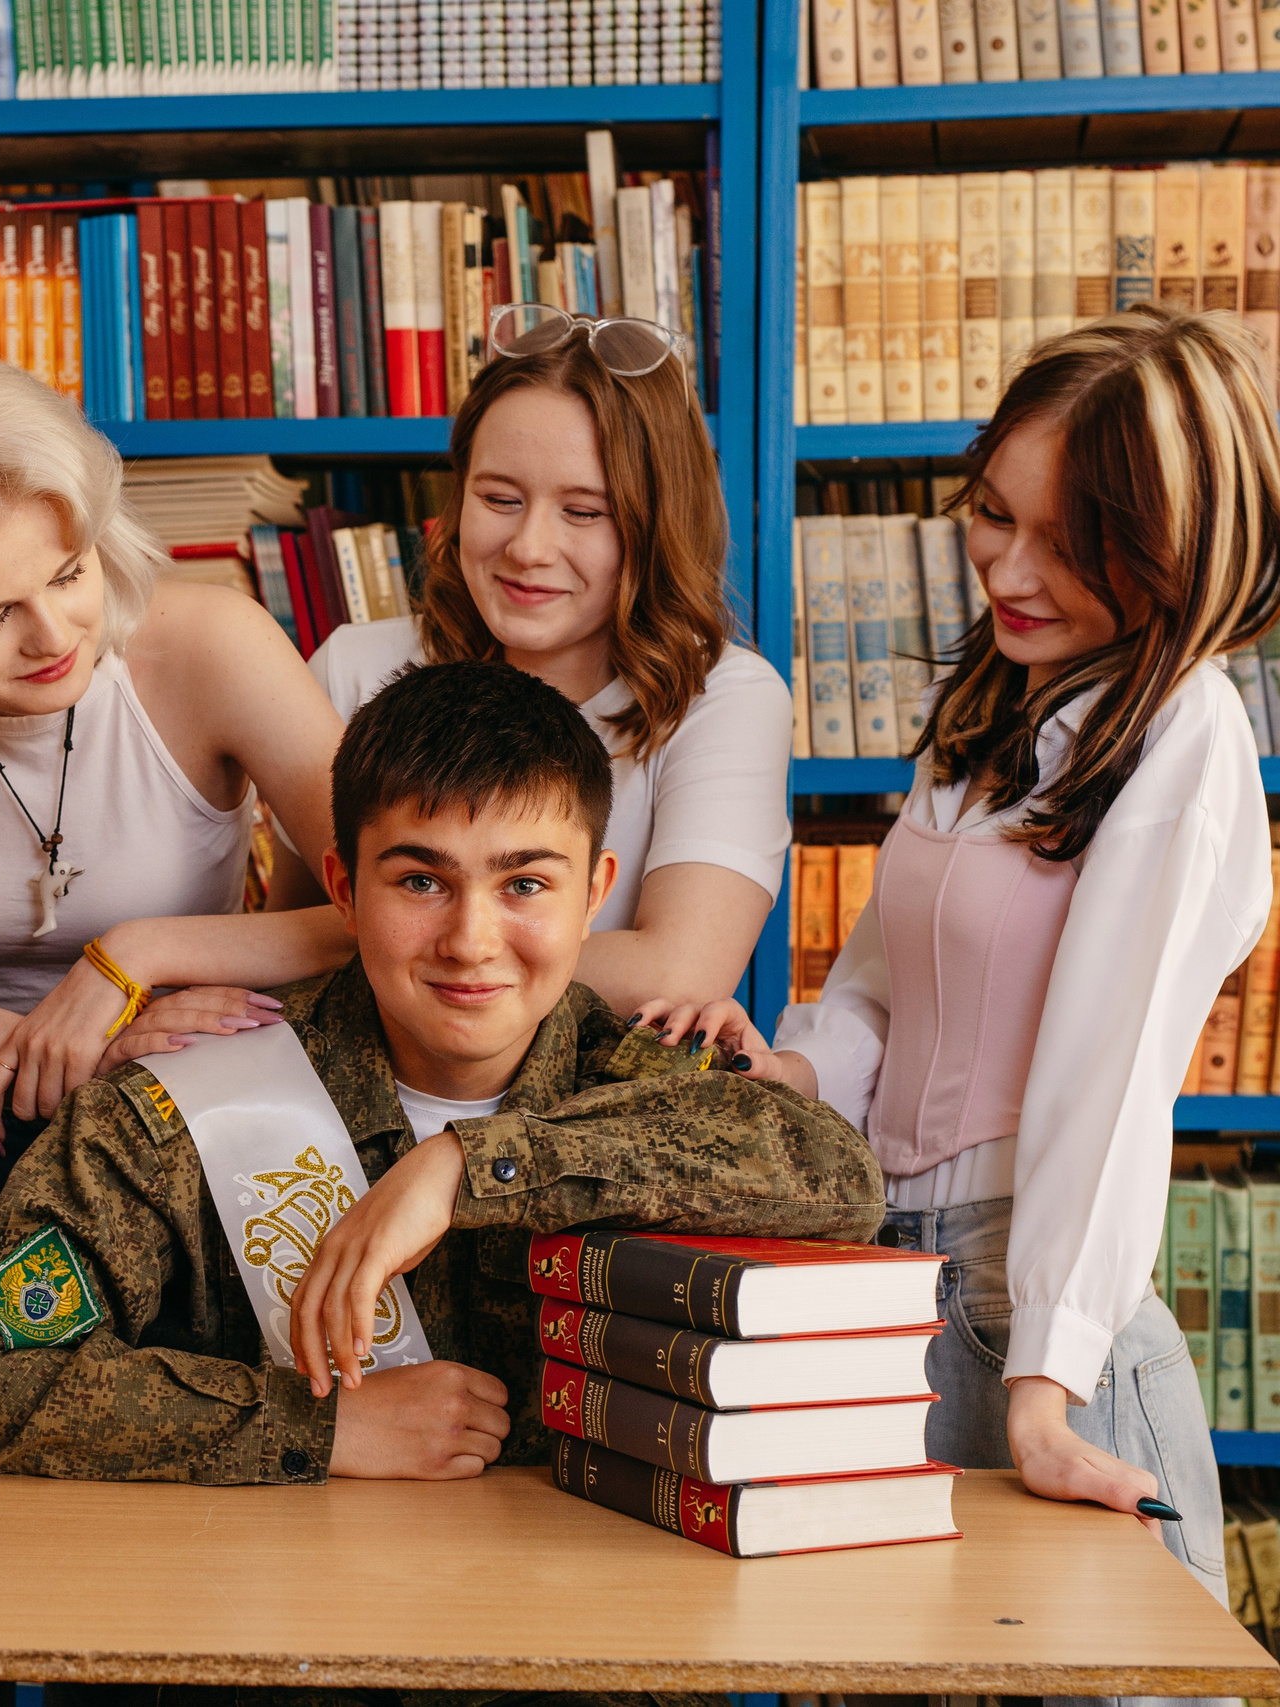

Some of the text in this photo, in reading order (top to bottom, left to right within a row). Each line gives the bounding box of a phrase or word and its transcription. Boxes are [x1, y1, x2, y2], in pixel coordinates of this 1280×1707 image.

[584, 1246, 594, 1302] БОЛЬШАЯ
[598, 1249, 606, 1306] ЭНЦИКЛОПЕДИЯ
[673, 1282, 685, 1306] 18
[711, 1277, 722, 1299] ХАК
[712, 1308, 721, 1328] ТРИ
[585, 1311, 595, 1366] БОЛЬШАЯ
[656, 1348, 666, 1371] 19
[688, 1344, 699, 1367] ЭДУ
[688, 1375, 697, 1395] ХАЛ
[584, 1381, 595, 1438] БОЛЬШАЯ
[657, 1422, 668, 1445] 17
[688, 1422, 697, 1442] ТРИ
[562, 1440, 571, 1460] САФ
[688, 1452, 696, 1470] СРЕ
[587, 1463, 599, 1486] 16
[669, 1471, 679, 1531] БОЛЬШАЯ
